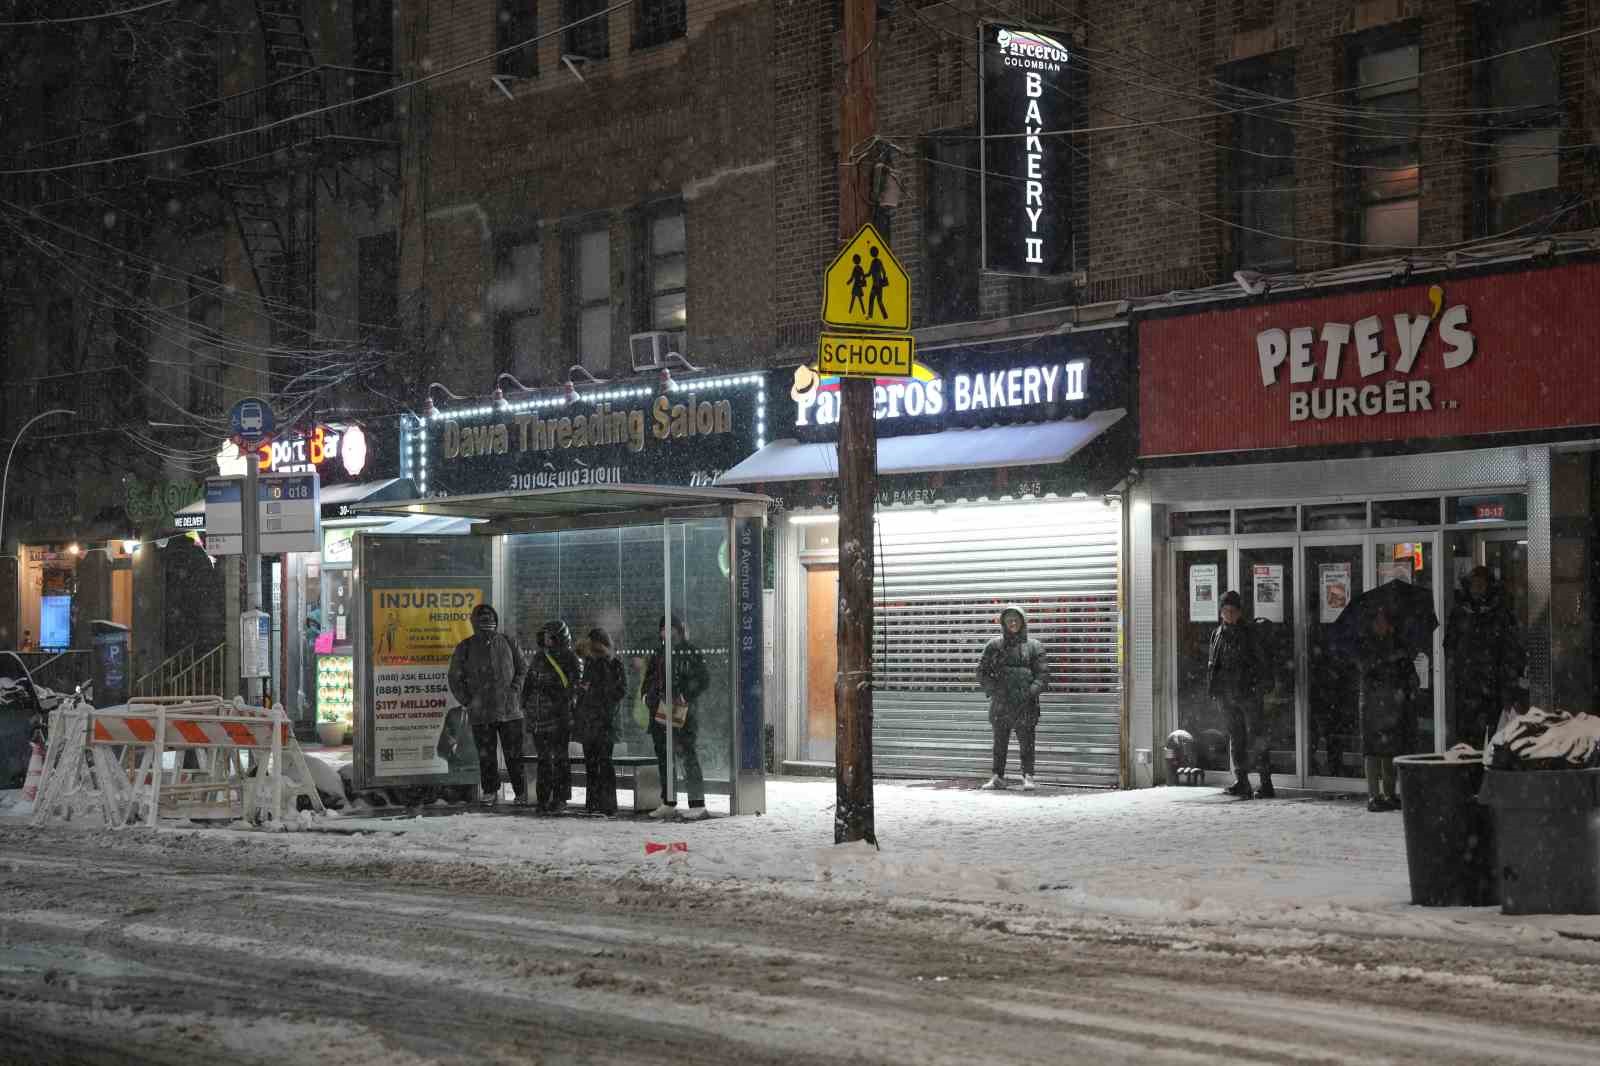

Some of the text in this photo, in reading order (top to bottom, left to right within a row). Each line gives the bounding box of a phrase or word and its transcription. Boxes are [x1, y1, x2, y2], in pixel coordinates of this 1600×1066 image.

[1004, 57, 1061, 72] COLOMBIAN
[1024, 72, 1043, 233] BAKERY
[823, 343, 907, 366] SCHOOL
[954, 364, 1059, 411] BAKERY
[1065, 361, 1085, 400] II
[1289, 379, 1433, 422] BURGER
[443, 393, 733, 459] Dawa Threading Salon
[310, 425, 340, 464] Bar
[893, 489, 937, 502] BAKERY
[175, 513, 204, 527] WE DELIVER
[380, 592, 475, 609] INJURED?
[742, 635, 753, 651] St
[375, 685, 401, 695] (888)
[375, 698, 446, 711] $117 MILLION
